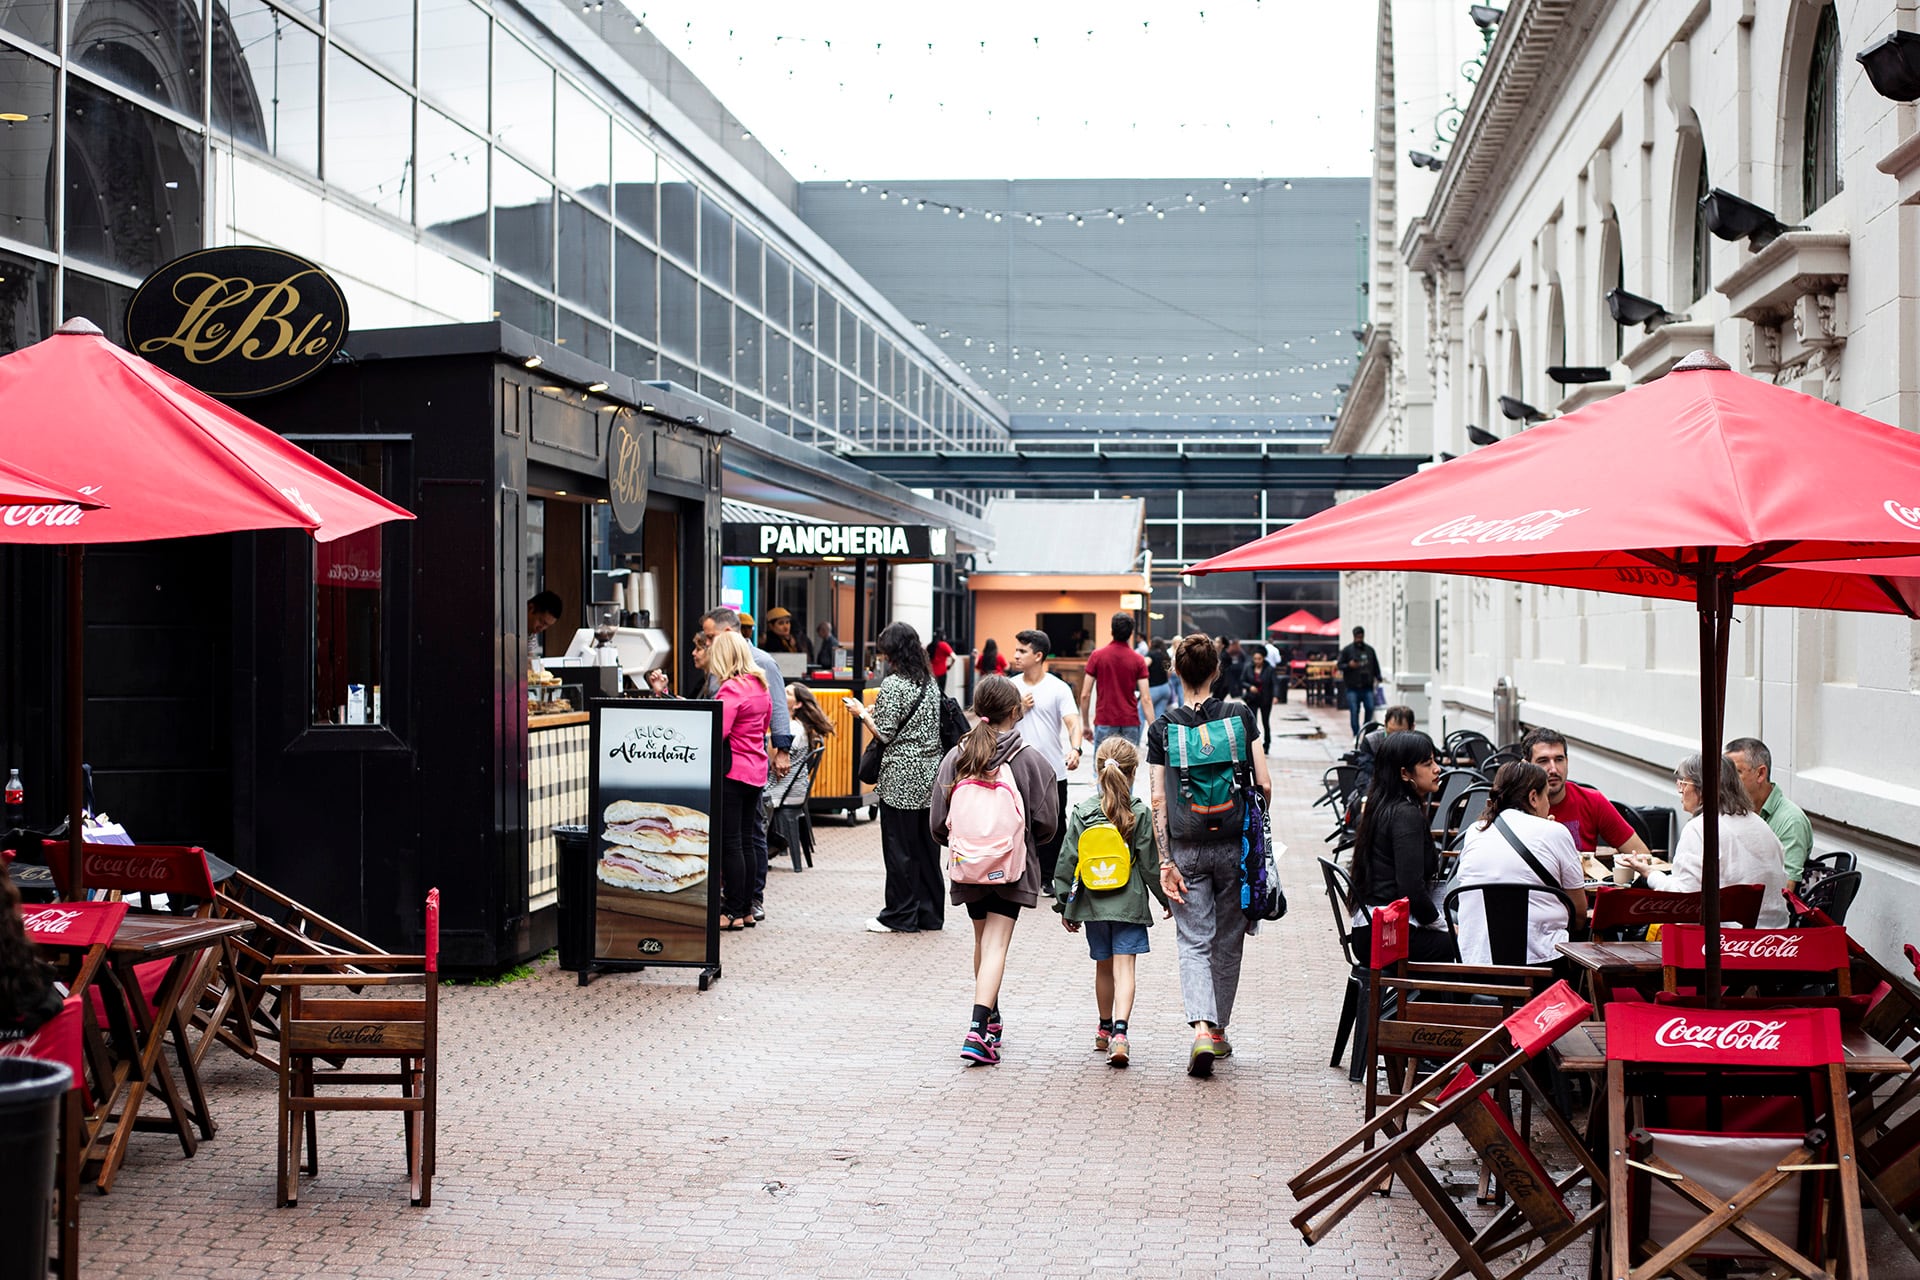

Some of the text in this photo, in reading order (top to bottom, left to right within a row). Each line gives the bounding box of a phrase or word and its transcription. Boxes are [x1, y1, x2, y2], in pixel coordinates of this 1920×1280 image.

[760, 525, 909, 554] PANCHERIA
[634, 725, 676, 741] RICO
[609, 741, 699, 763] Abundante
[645, 739, 657, 750] &
[85, 854, 169, 880] Coca-Cola
[327, 1024, 386, 1044] Coca-Cola
[1411, 1027, 1464, 1048] Coca-Cola
[1655, 1017, 1787, 1051] Coca-Cola
